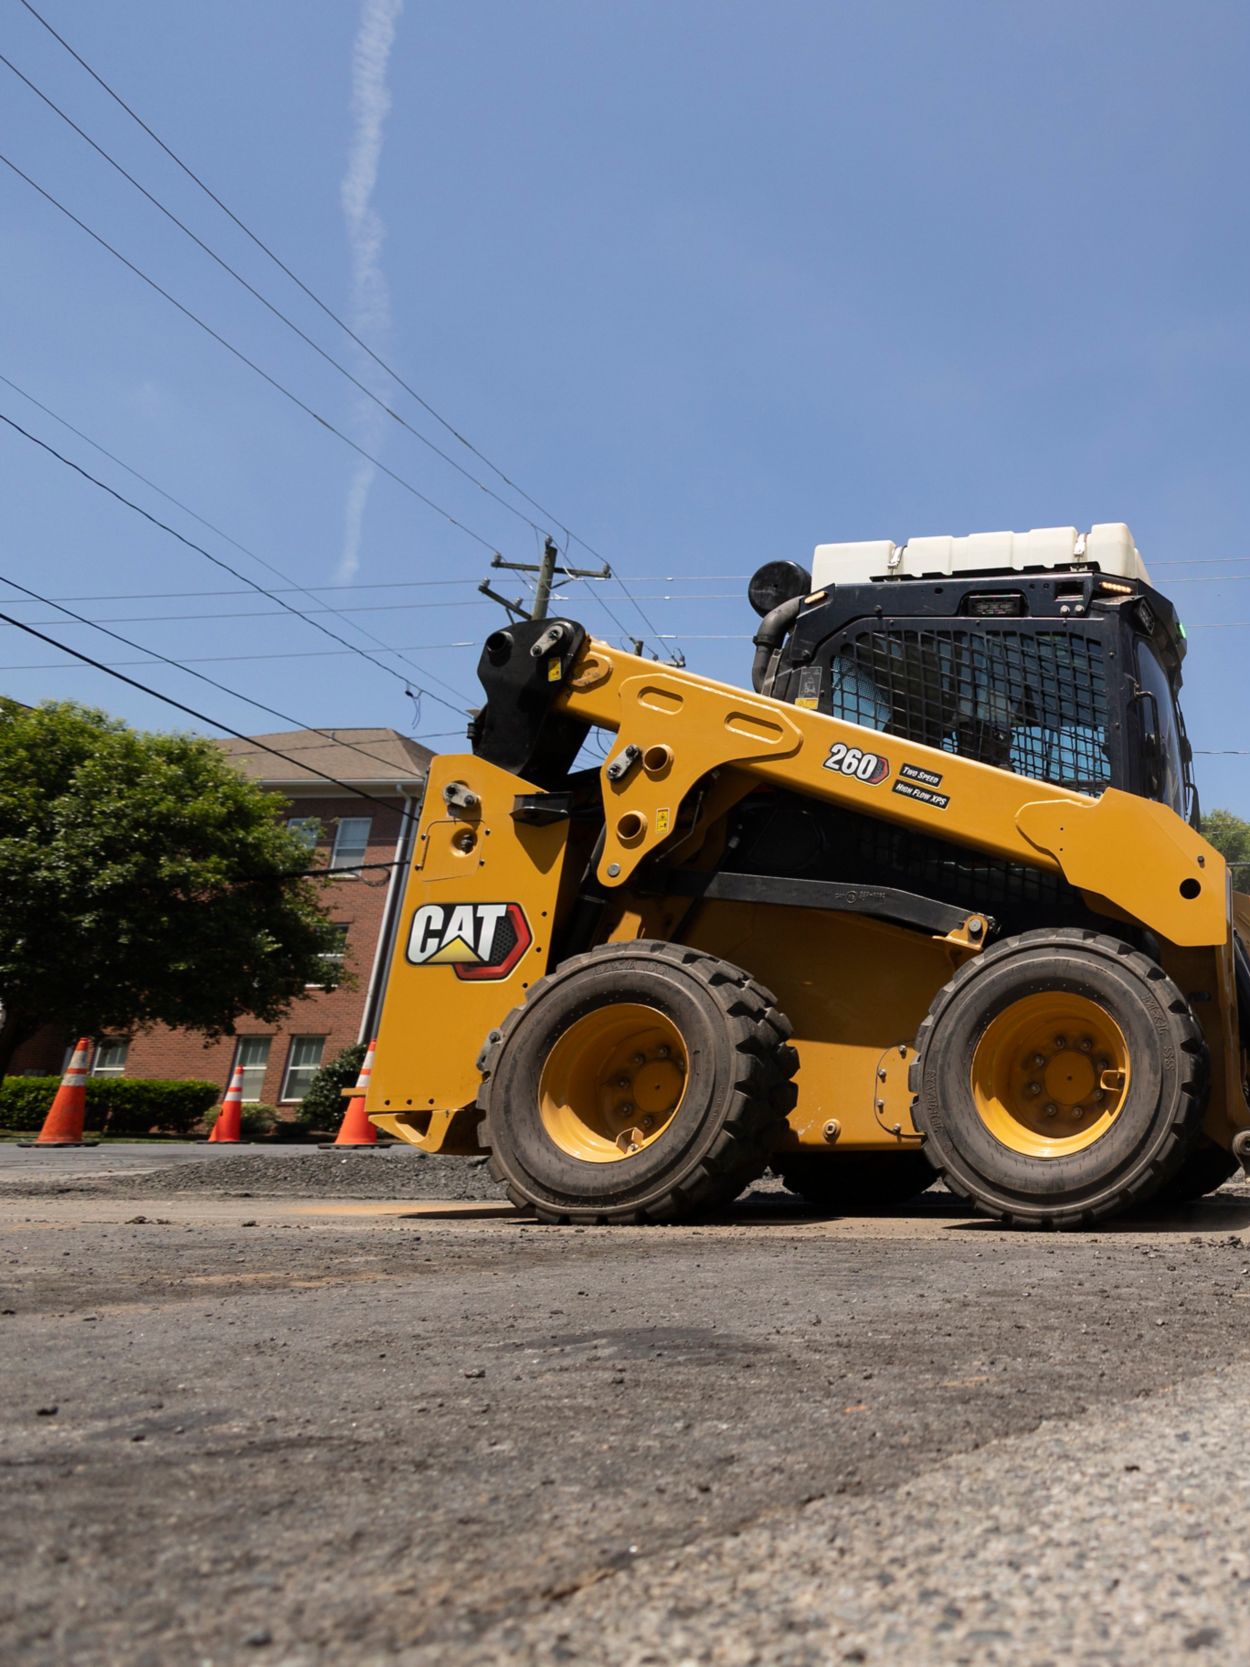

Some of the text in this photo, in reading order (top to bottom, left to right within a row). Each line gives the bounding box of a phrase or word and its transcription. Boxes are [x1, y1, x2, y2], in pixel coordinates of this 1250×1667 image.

[824, 743, 878, 780] 260
[930, 794, 947, 806] XPS
[407, 903, 508, 964] CAT
